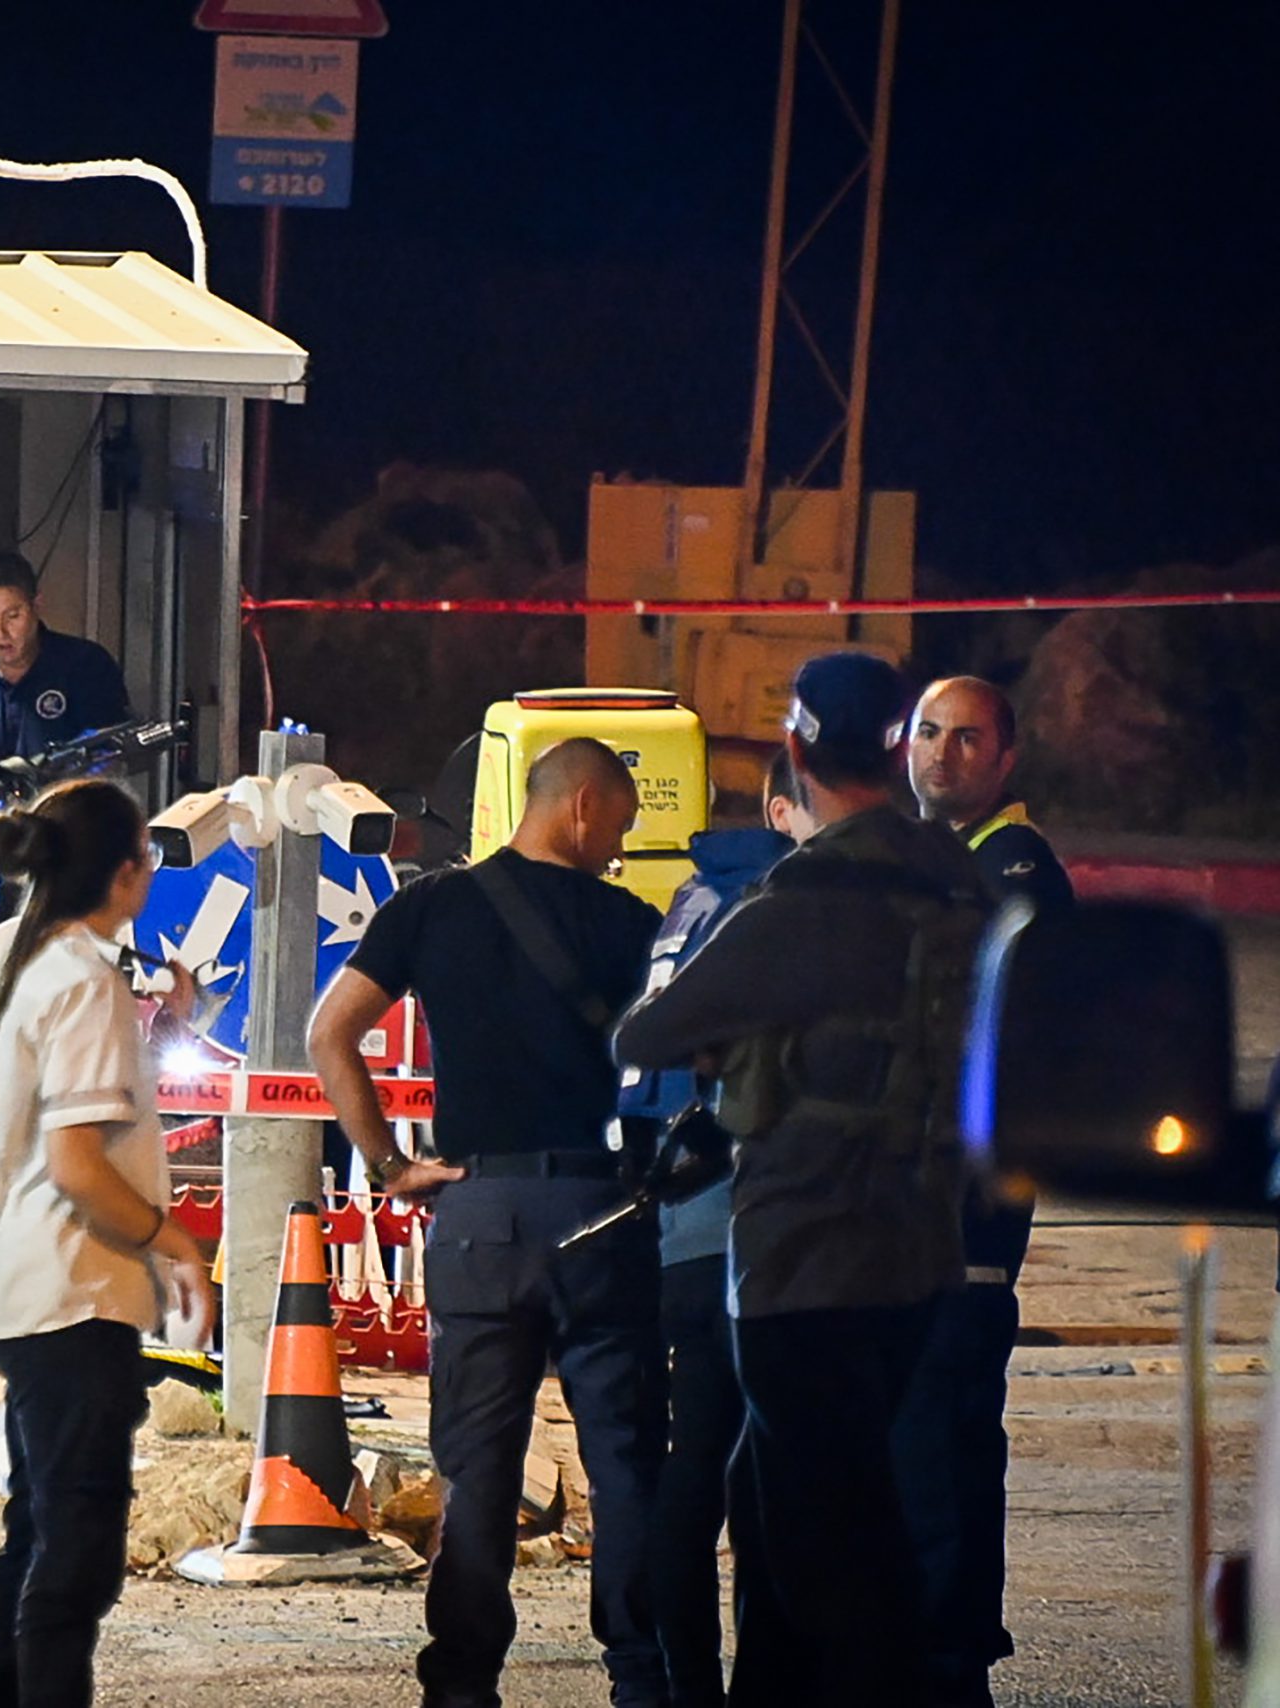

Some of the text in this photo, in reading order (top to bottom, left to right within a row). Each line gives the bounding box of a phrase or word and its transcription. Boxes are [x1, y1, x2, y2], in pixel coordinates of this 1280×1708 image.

[637, 777, 679, 788] מגן דו
[644, 790, 678, 800] אדום
[639, 801, 679, 812] בישרא
[262, 1083, 326, 1101] משט
